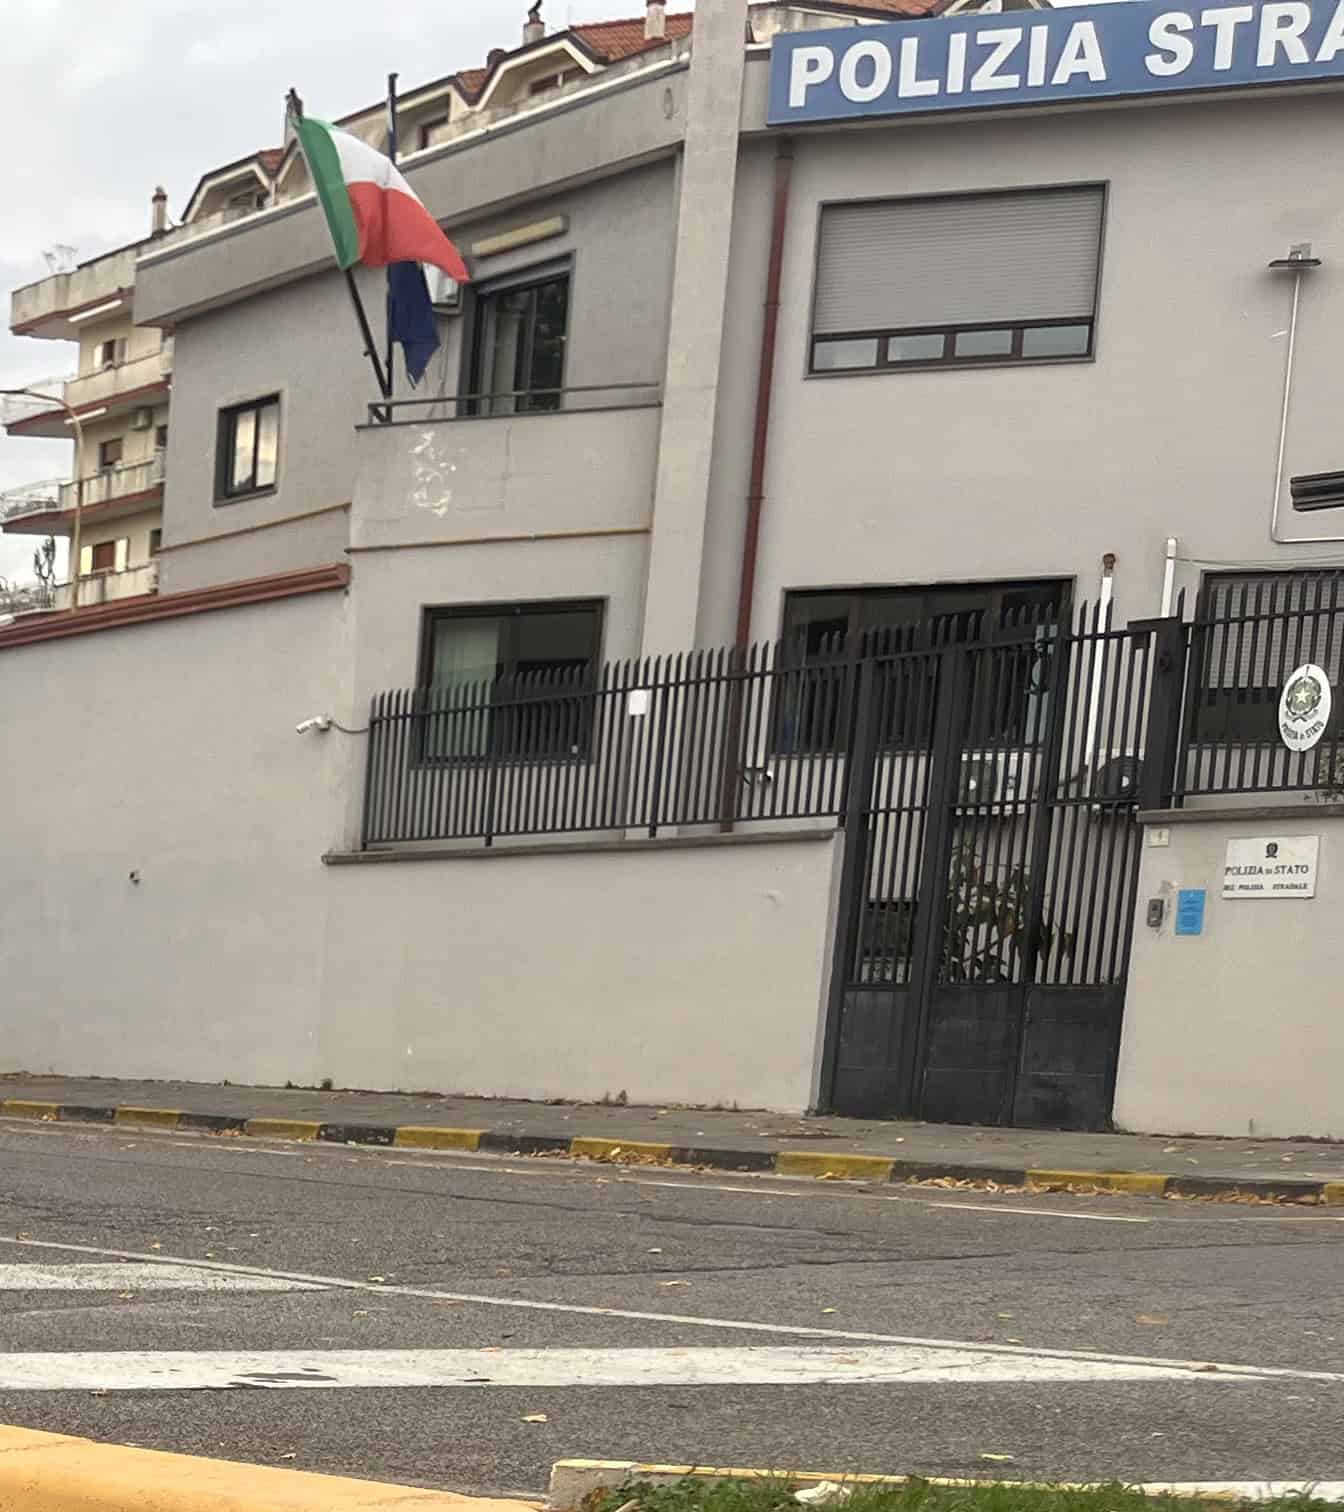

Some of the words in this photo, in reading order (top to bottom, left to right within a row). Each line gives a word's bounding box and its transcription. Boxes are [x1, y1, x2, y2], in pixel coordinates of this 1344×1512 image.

[788, 20, 1107, 108] POLIZIA
[1224, 865, 1264, 876] POLIZIA
[1273, 864, 1309, 875] STATO
